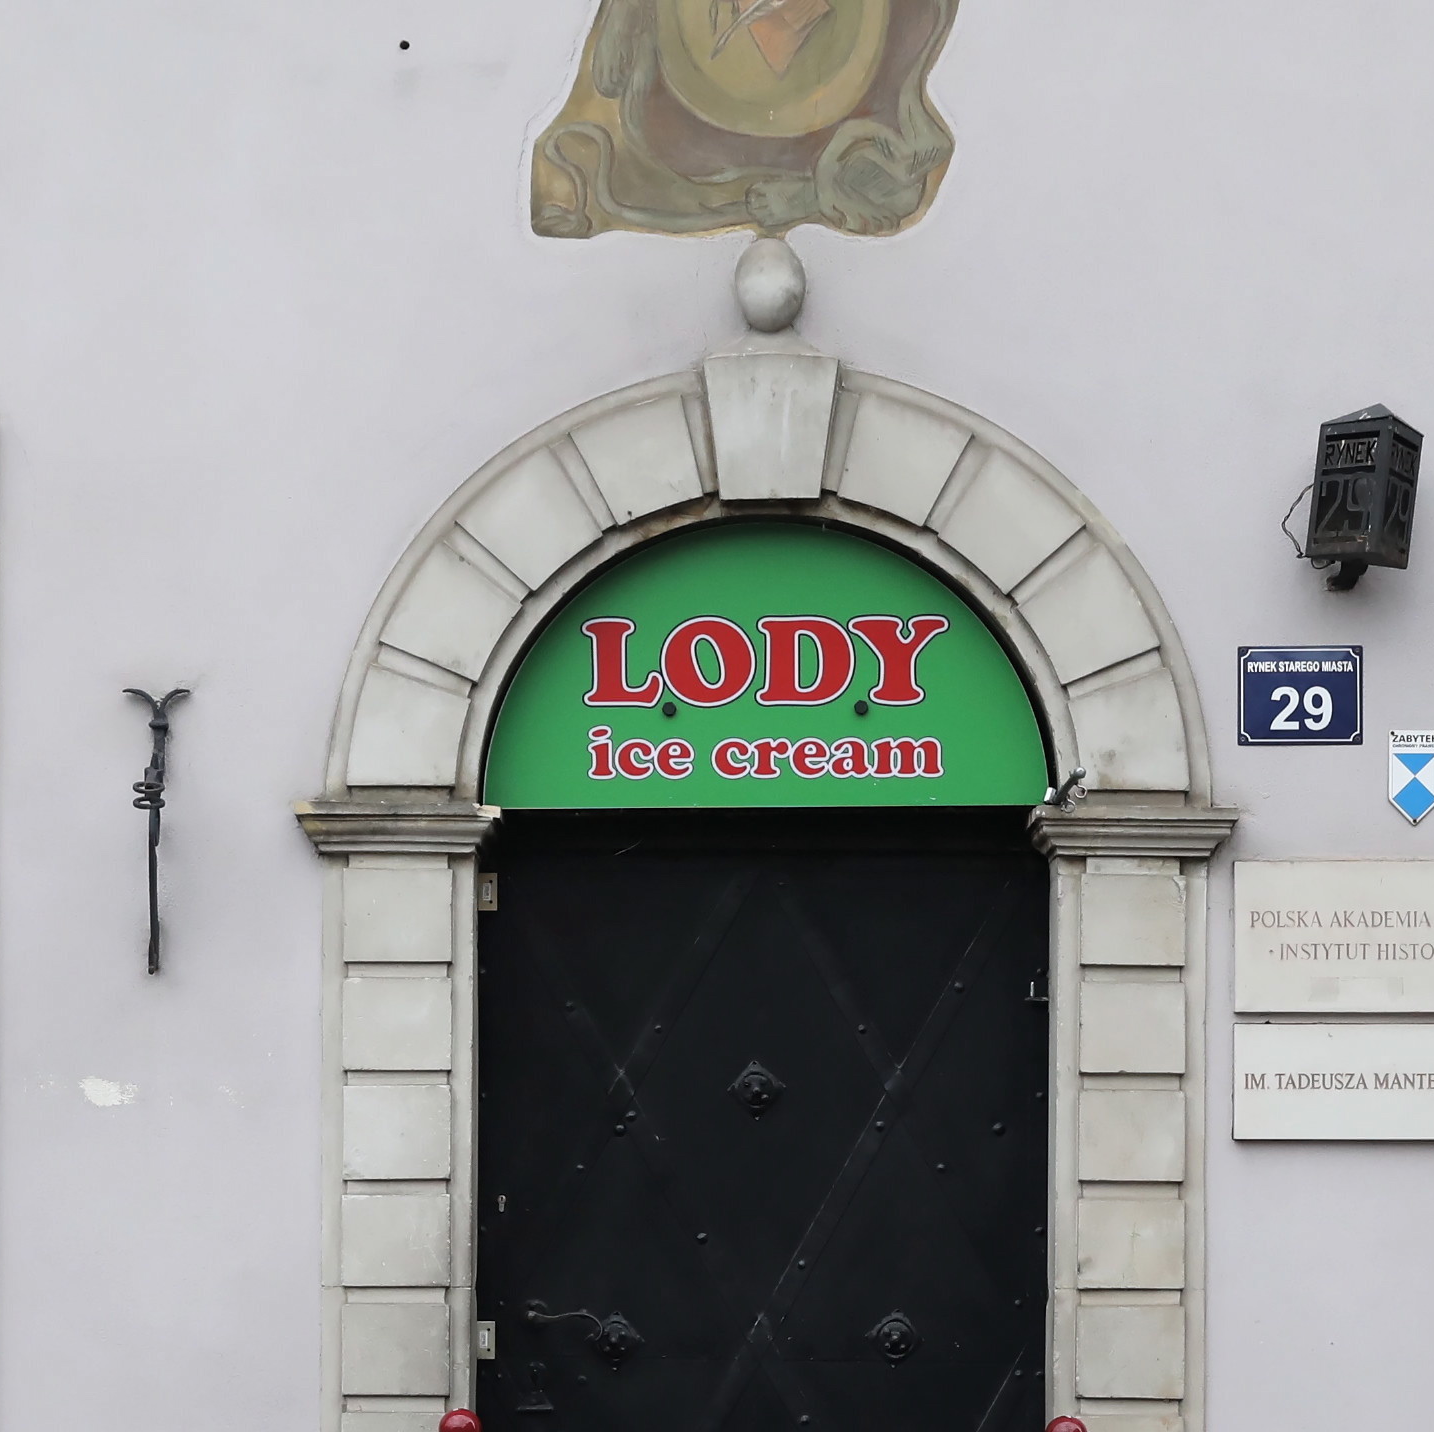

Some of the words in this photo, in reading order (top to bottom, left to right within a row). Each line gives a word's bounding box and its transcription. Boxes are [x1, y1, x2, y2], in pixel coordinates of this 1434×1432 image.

[1325, 440, 1377, 466] RYNEK
[581, 615, 949, 708] LODY
[1247, 661, 1277, 673] RYNEK
[1278, 661, 1320, 672] STAREGO
[1321, 660, 1354, 672] MIASTA
[1270, 686, 1333, 731] 29
[587, 725, 694, 780] ice
[711, 735, 944, 780] cream
[1250, 910, 1323, 928] POLSKA
[1330, 910, 1432, 928] AKADEMIA
[1280, 943, 1371, 960] INSTYTUT
[1244, 1073, 1270, 1090] IM.
[1275, 1073, 1369, 1090] TADEUSZA
